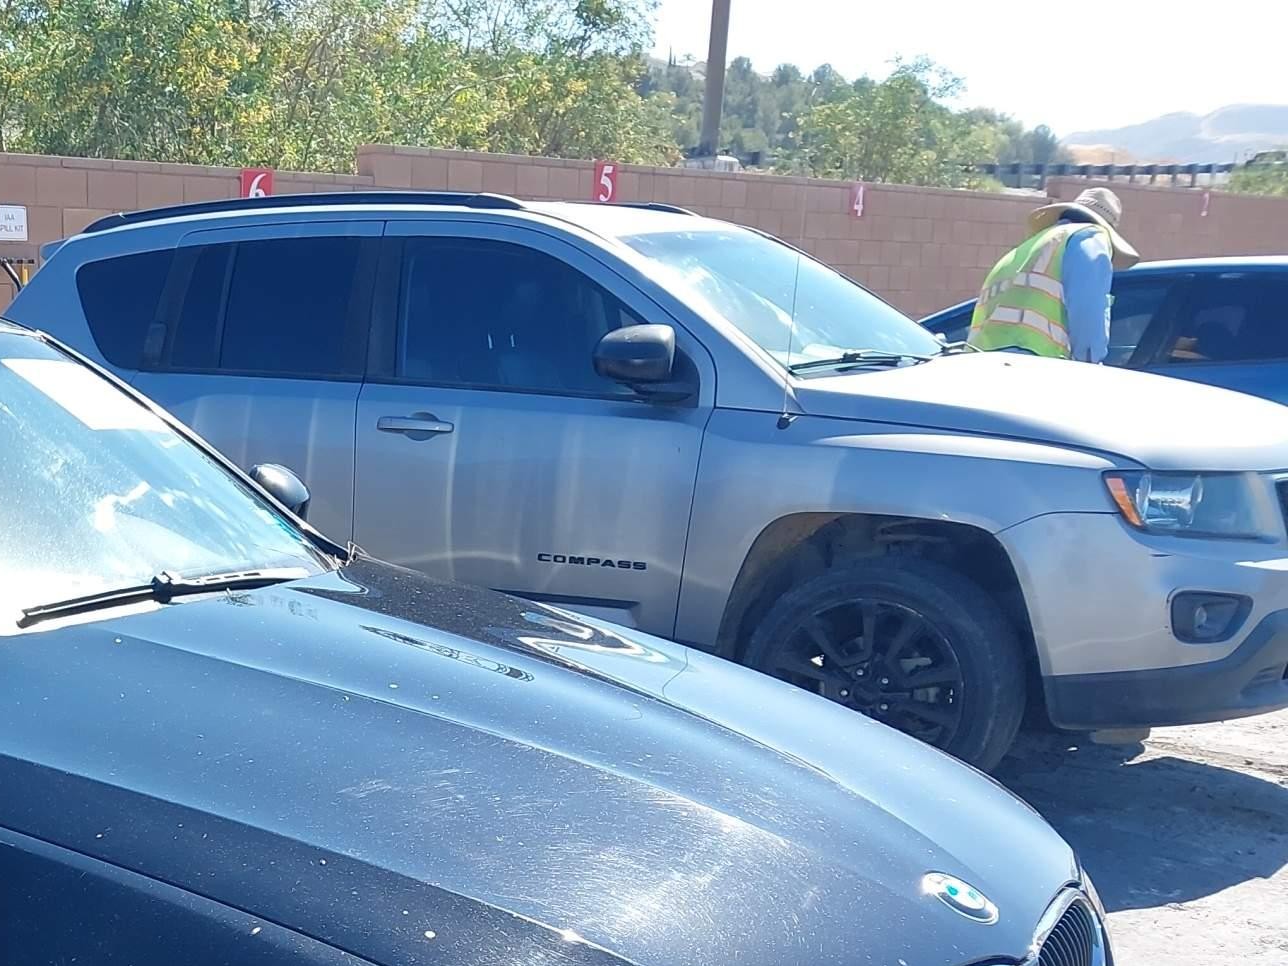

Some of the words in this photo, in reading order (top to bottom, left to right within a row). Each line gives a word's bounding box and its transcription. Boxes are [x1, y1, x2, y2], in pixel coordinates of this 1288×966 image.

[249, 173, 267, 198] 6
[599, 165, 614, 202] 5
[854, 186, 864, 217] 4
[537, 553, 647, 571] COMPASS
